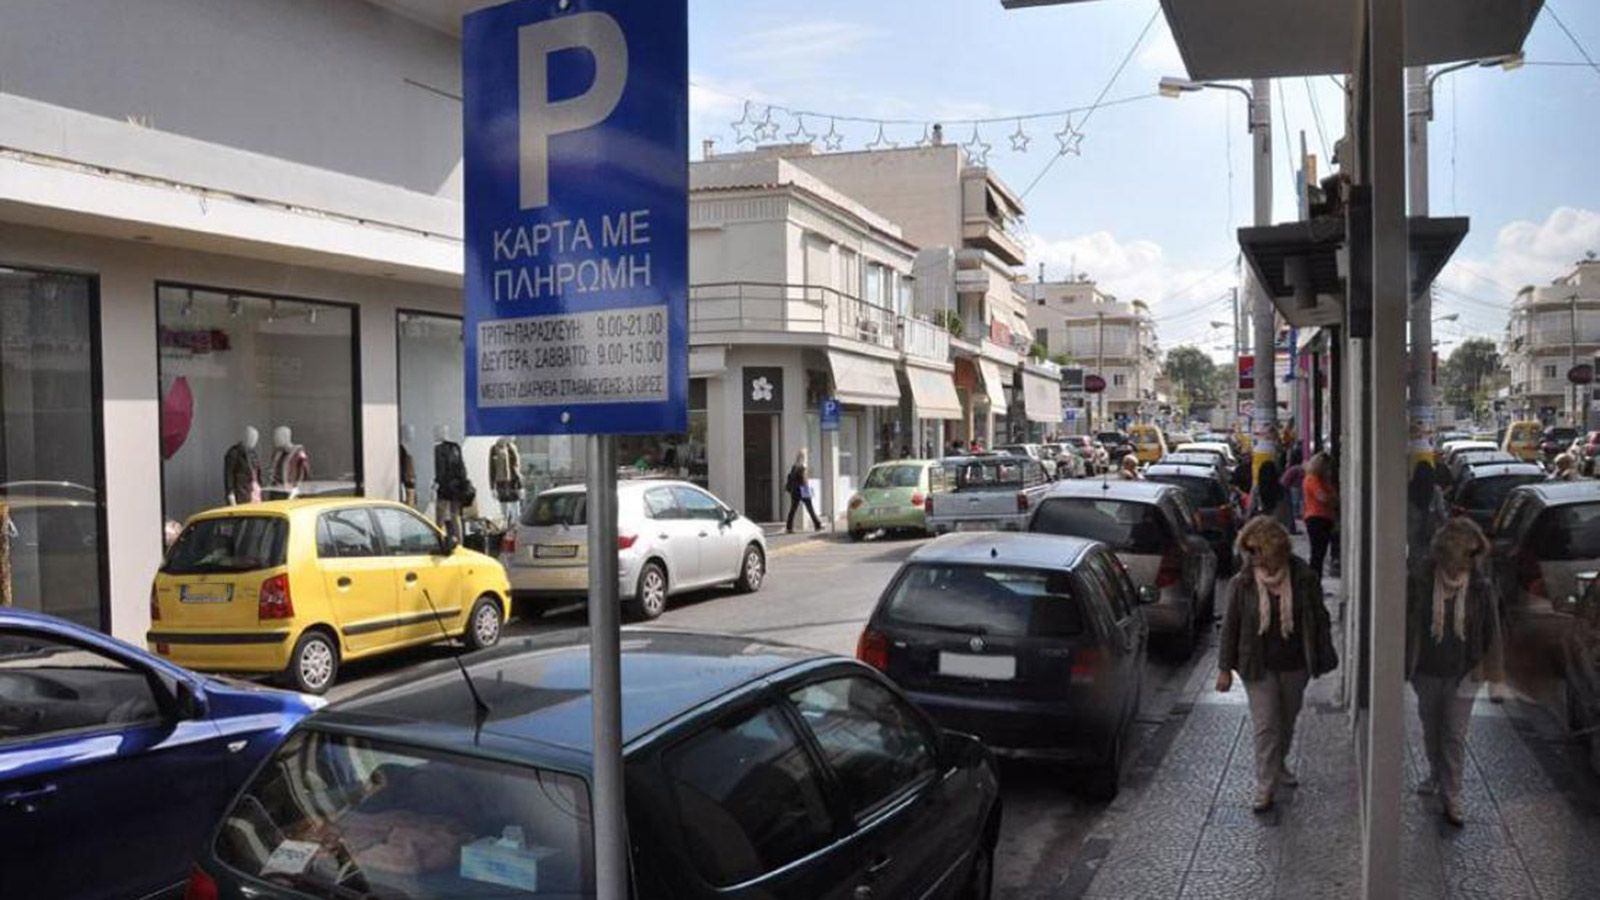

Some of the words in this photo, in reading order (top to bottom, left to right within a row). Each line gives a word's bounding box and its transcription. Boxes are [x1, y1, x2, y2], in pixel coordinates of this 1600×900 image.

[517, 11, 629, 210] P
[494, 218, 593, 260] ΚΑΡΤΑ
[603, 210, 650, 247] ΜΕ
[494, 253, 650, 300] ΠΛΗΡΩΜΗ
[596, 311, 663, 338] 9.00-21.00
[596, 340, 663, 365] 9.00-15.00
